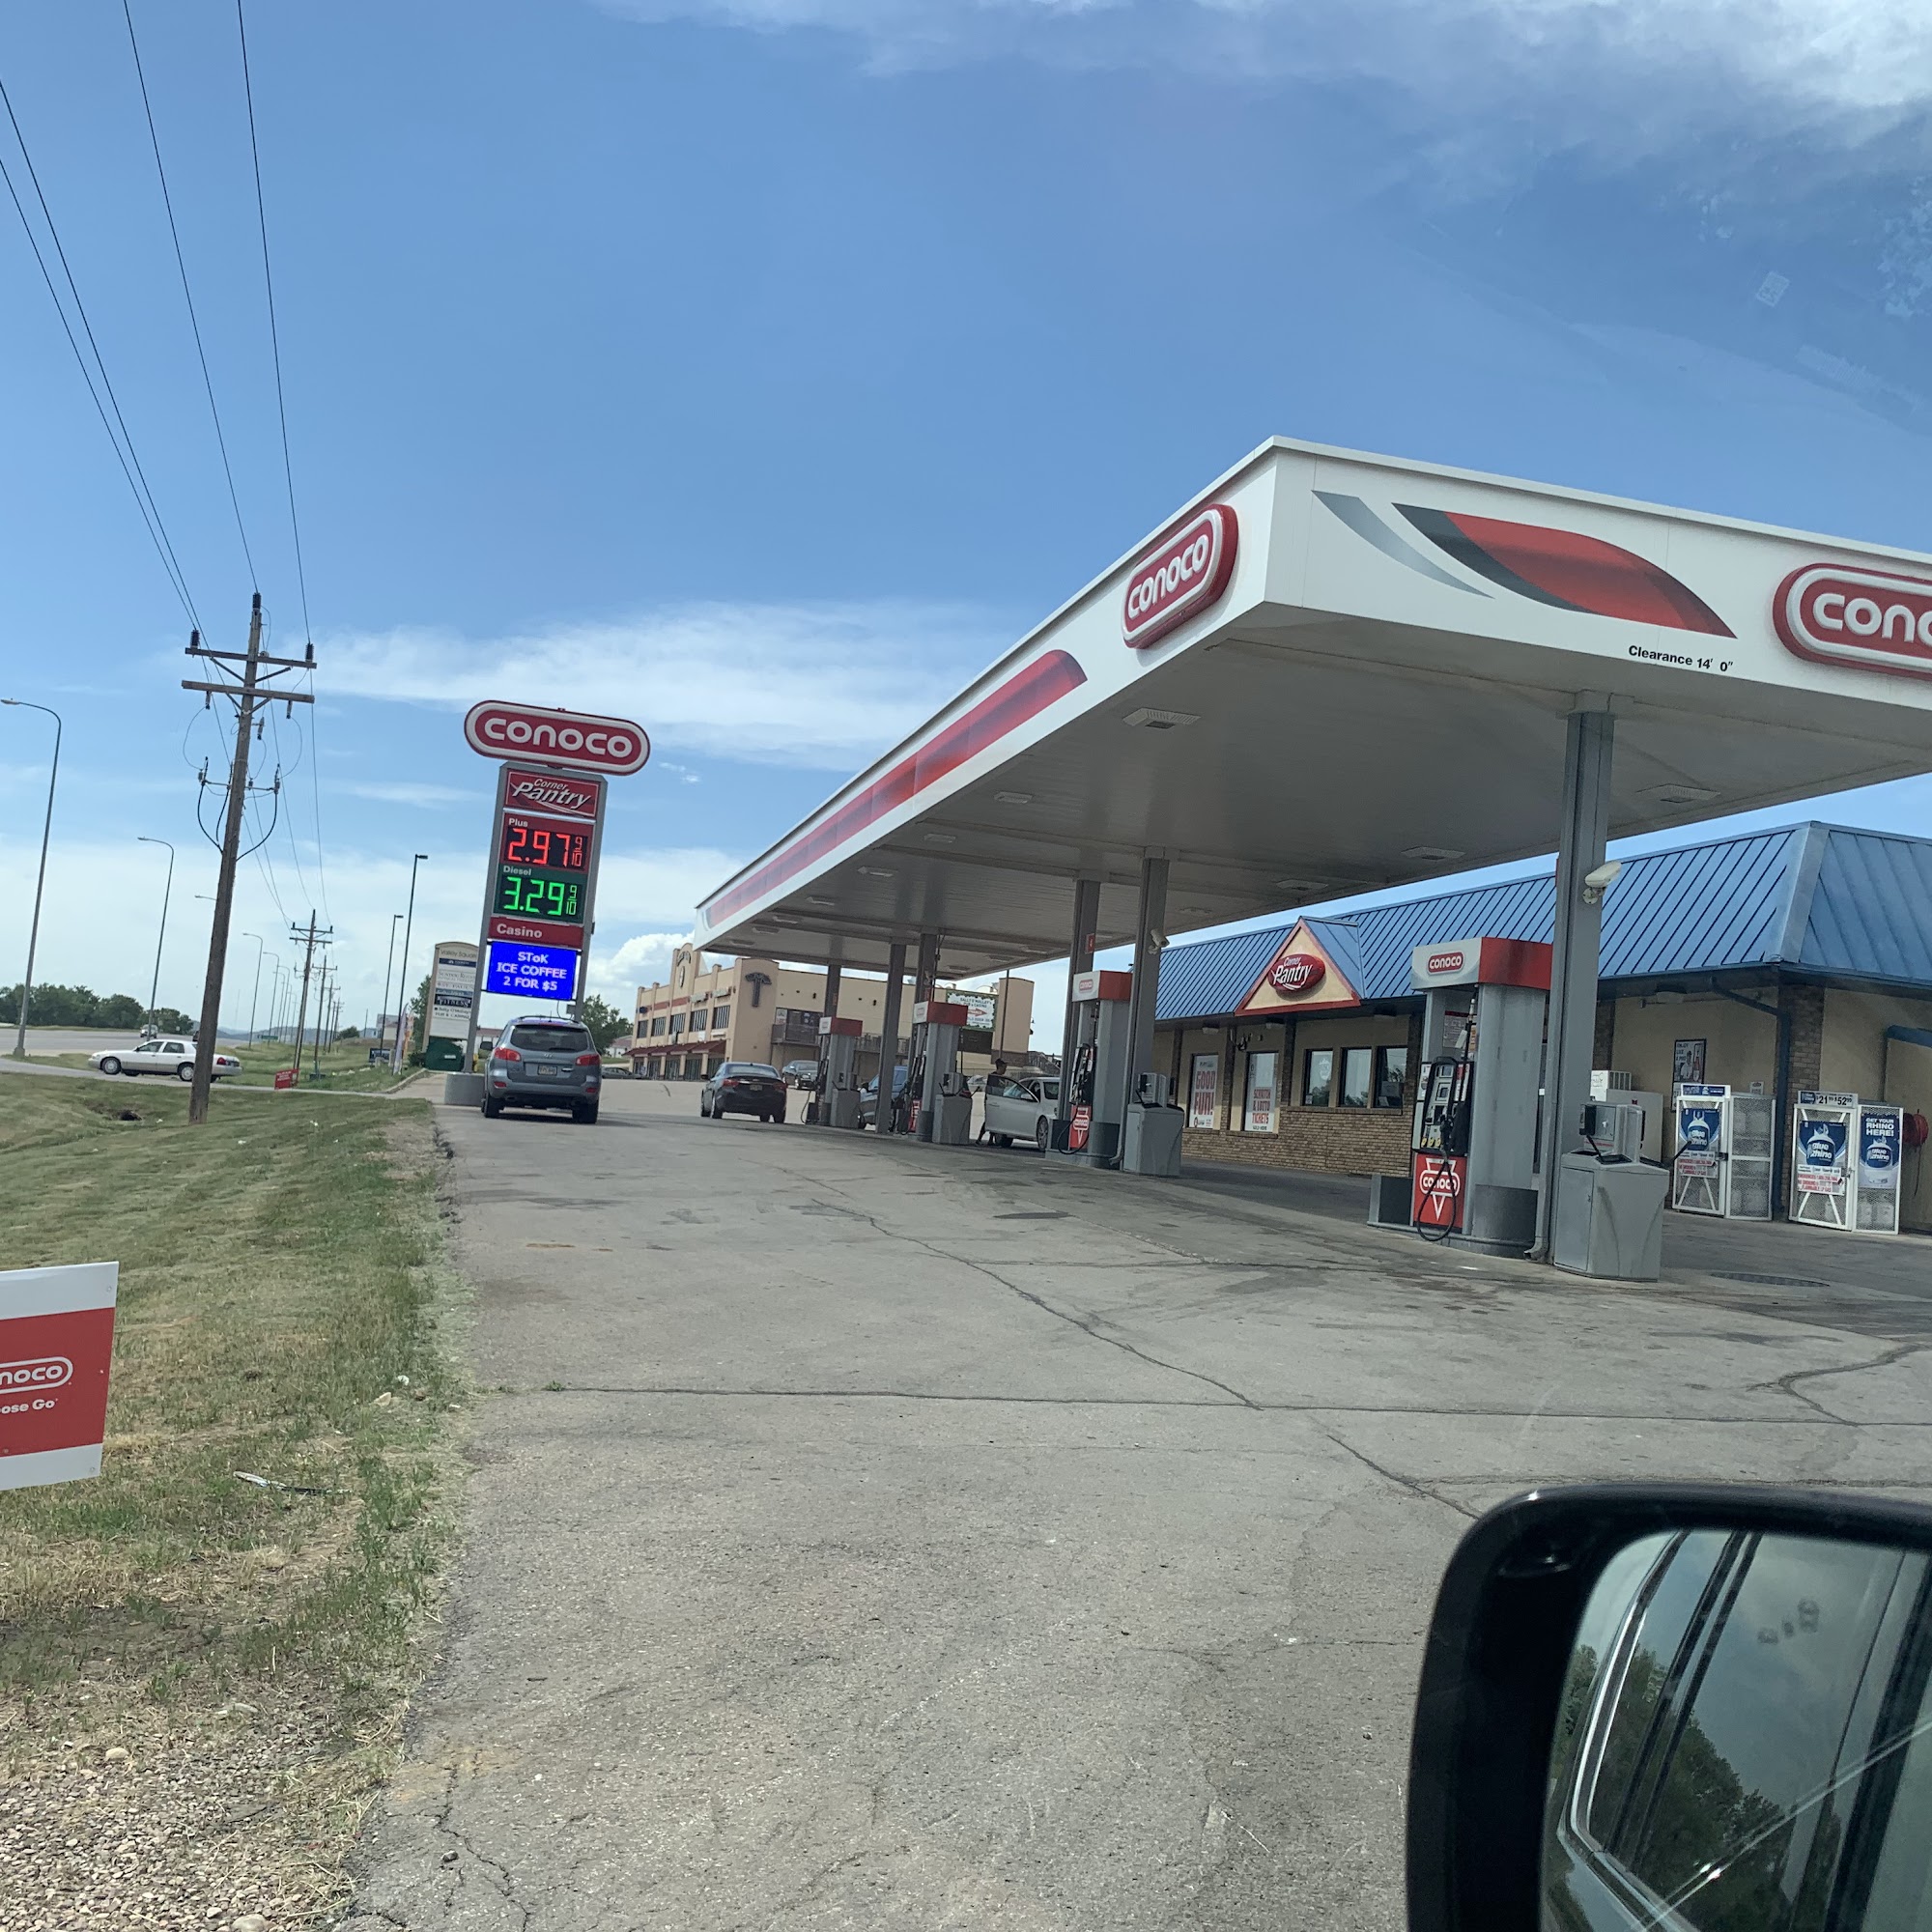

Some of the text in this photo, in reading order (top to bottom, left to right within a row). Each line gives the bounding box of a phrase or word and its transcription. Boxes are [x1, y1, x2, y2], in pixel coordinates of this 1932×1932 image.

[1629, 645, 1692, 666] Clearance
[533, 778, 568, 791] Corner
[512, 781, 592, 810] Pantry
[508, 817, 528, 828] Plus
[503, 865, 532, 876] Diesel
[497, 923, 543, 938] Casino
[1283, 956, 1302, 967] Corner
[496, 962, 567, 979] ICE COFFEE
[1271, 962, 1314, 986] Pantry
[503, 976, 558, 992] 2 FOR $5
[1195, 1070, 1216, 1090] GOOD
[1193, 1092, 1214, 1116] FUN!
[1257, 1100, 1270, 1112] LOTTO
[1252, 1112, 1269, 1124] TICKETS
[32, 1399, 56, 1410] Go
